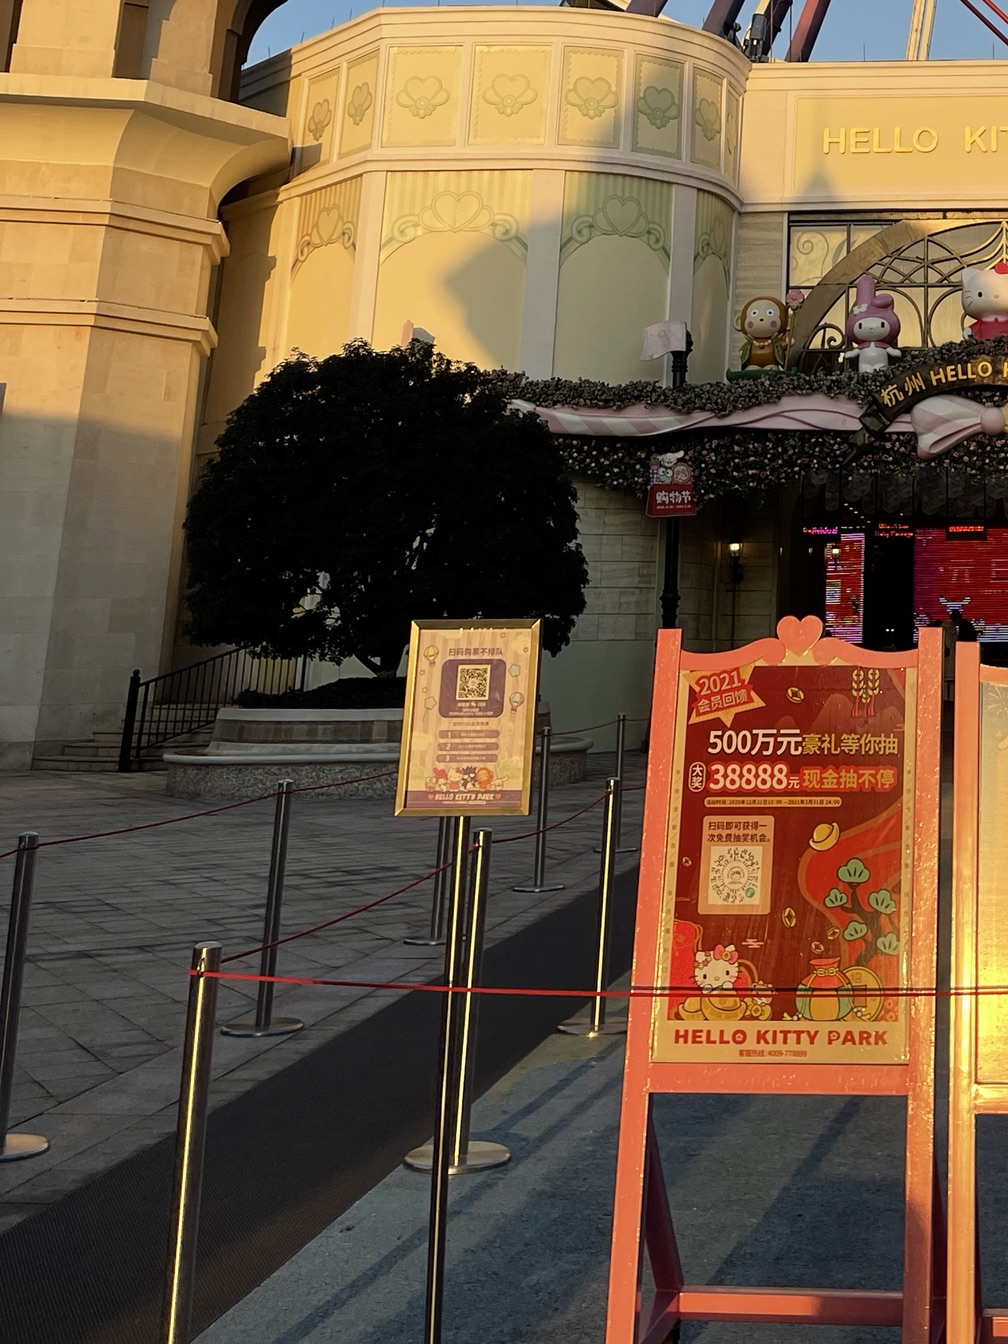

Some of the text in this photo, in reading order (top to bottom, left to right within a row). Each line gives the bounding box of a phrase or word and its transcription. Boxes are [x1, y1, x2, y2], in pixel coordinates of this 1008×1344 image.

[822, 127, 939, 154] HELLO
[880, 372, 925, 407] 杭州
[929, 361, 993, 386] HELLO
[656, 490, 691, 504] 购物节
[449, 647, 503, 656] 扫码购票不排队
[698, 671, 742, 695] 2021
[697, 689, 749, 713] 会员回馈
[455, 793, 476, 801] KITTY
[708, 821, 768, 831] 扫码即可获得一
[707, 833, 770, 843] 次免费抽奖机会。
[674, 1029, 889, 1046] HELLO KITTY PARK
